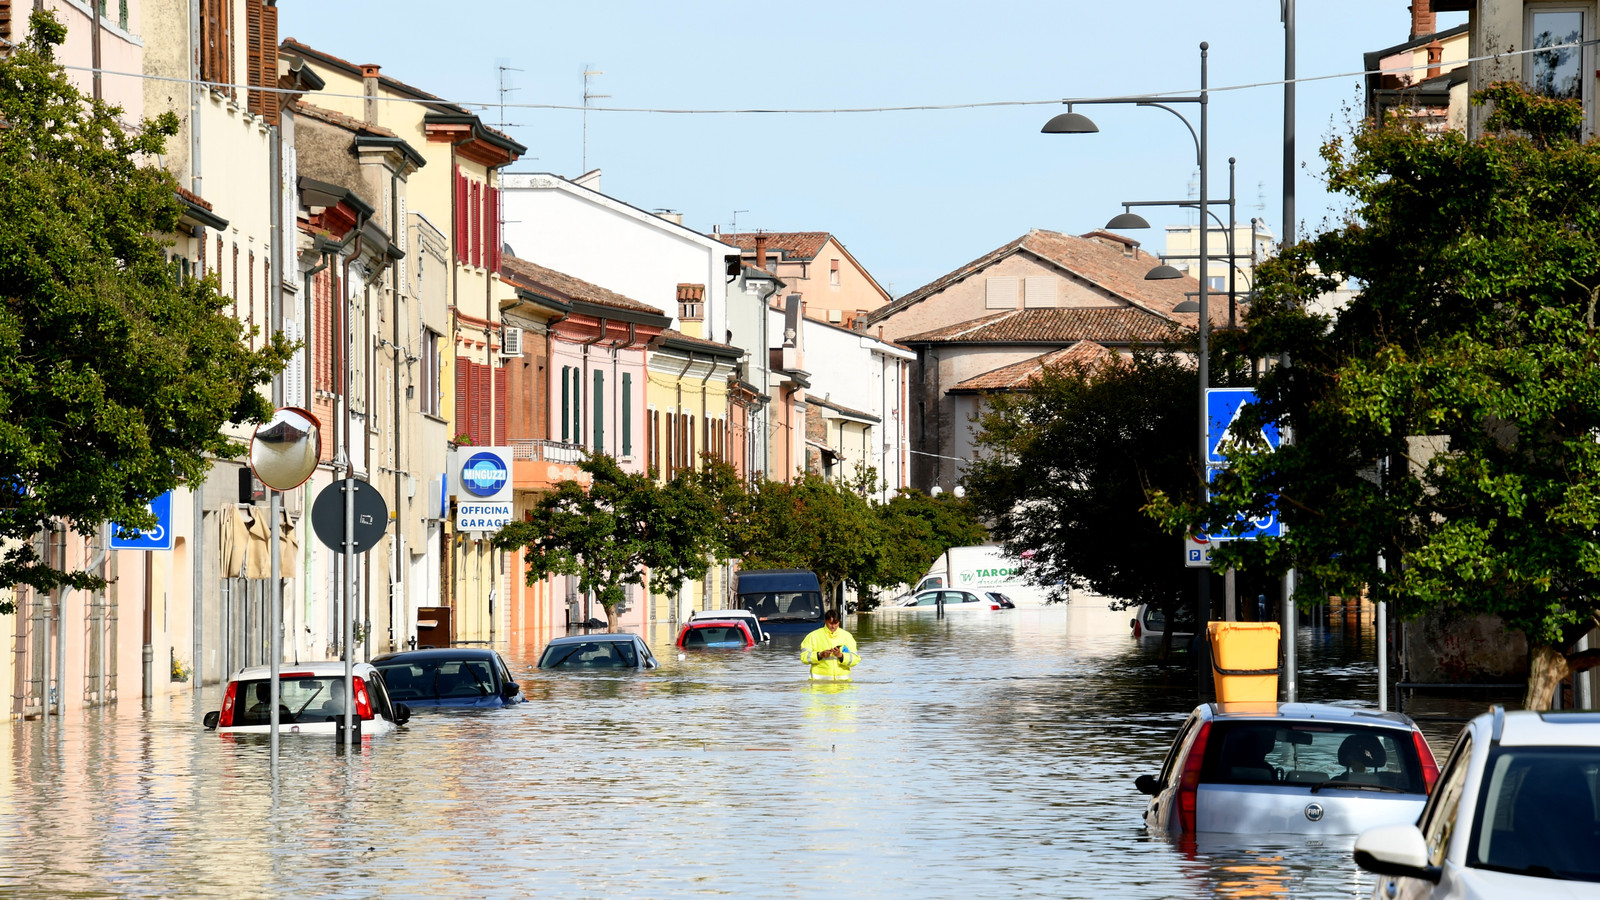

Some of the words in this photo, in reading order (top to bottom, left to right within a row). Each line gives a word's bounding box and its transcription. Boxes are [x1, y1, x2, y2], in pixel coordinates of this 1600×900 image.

[464, 469, 506, 480] MINGUZZI
[461, 506, 509, 515] OFFICINA
[1191, 551, 1199, 560] P
